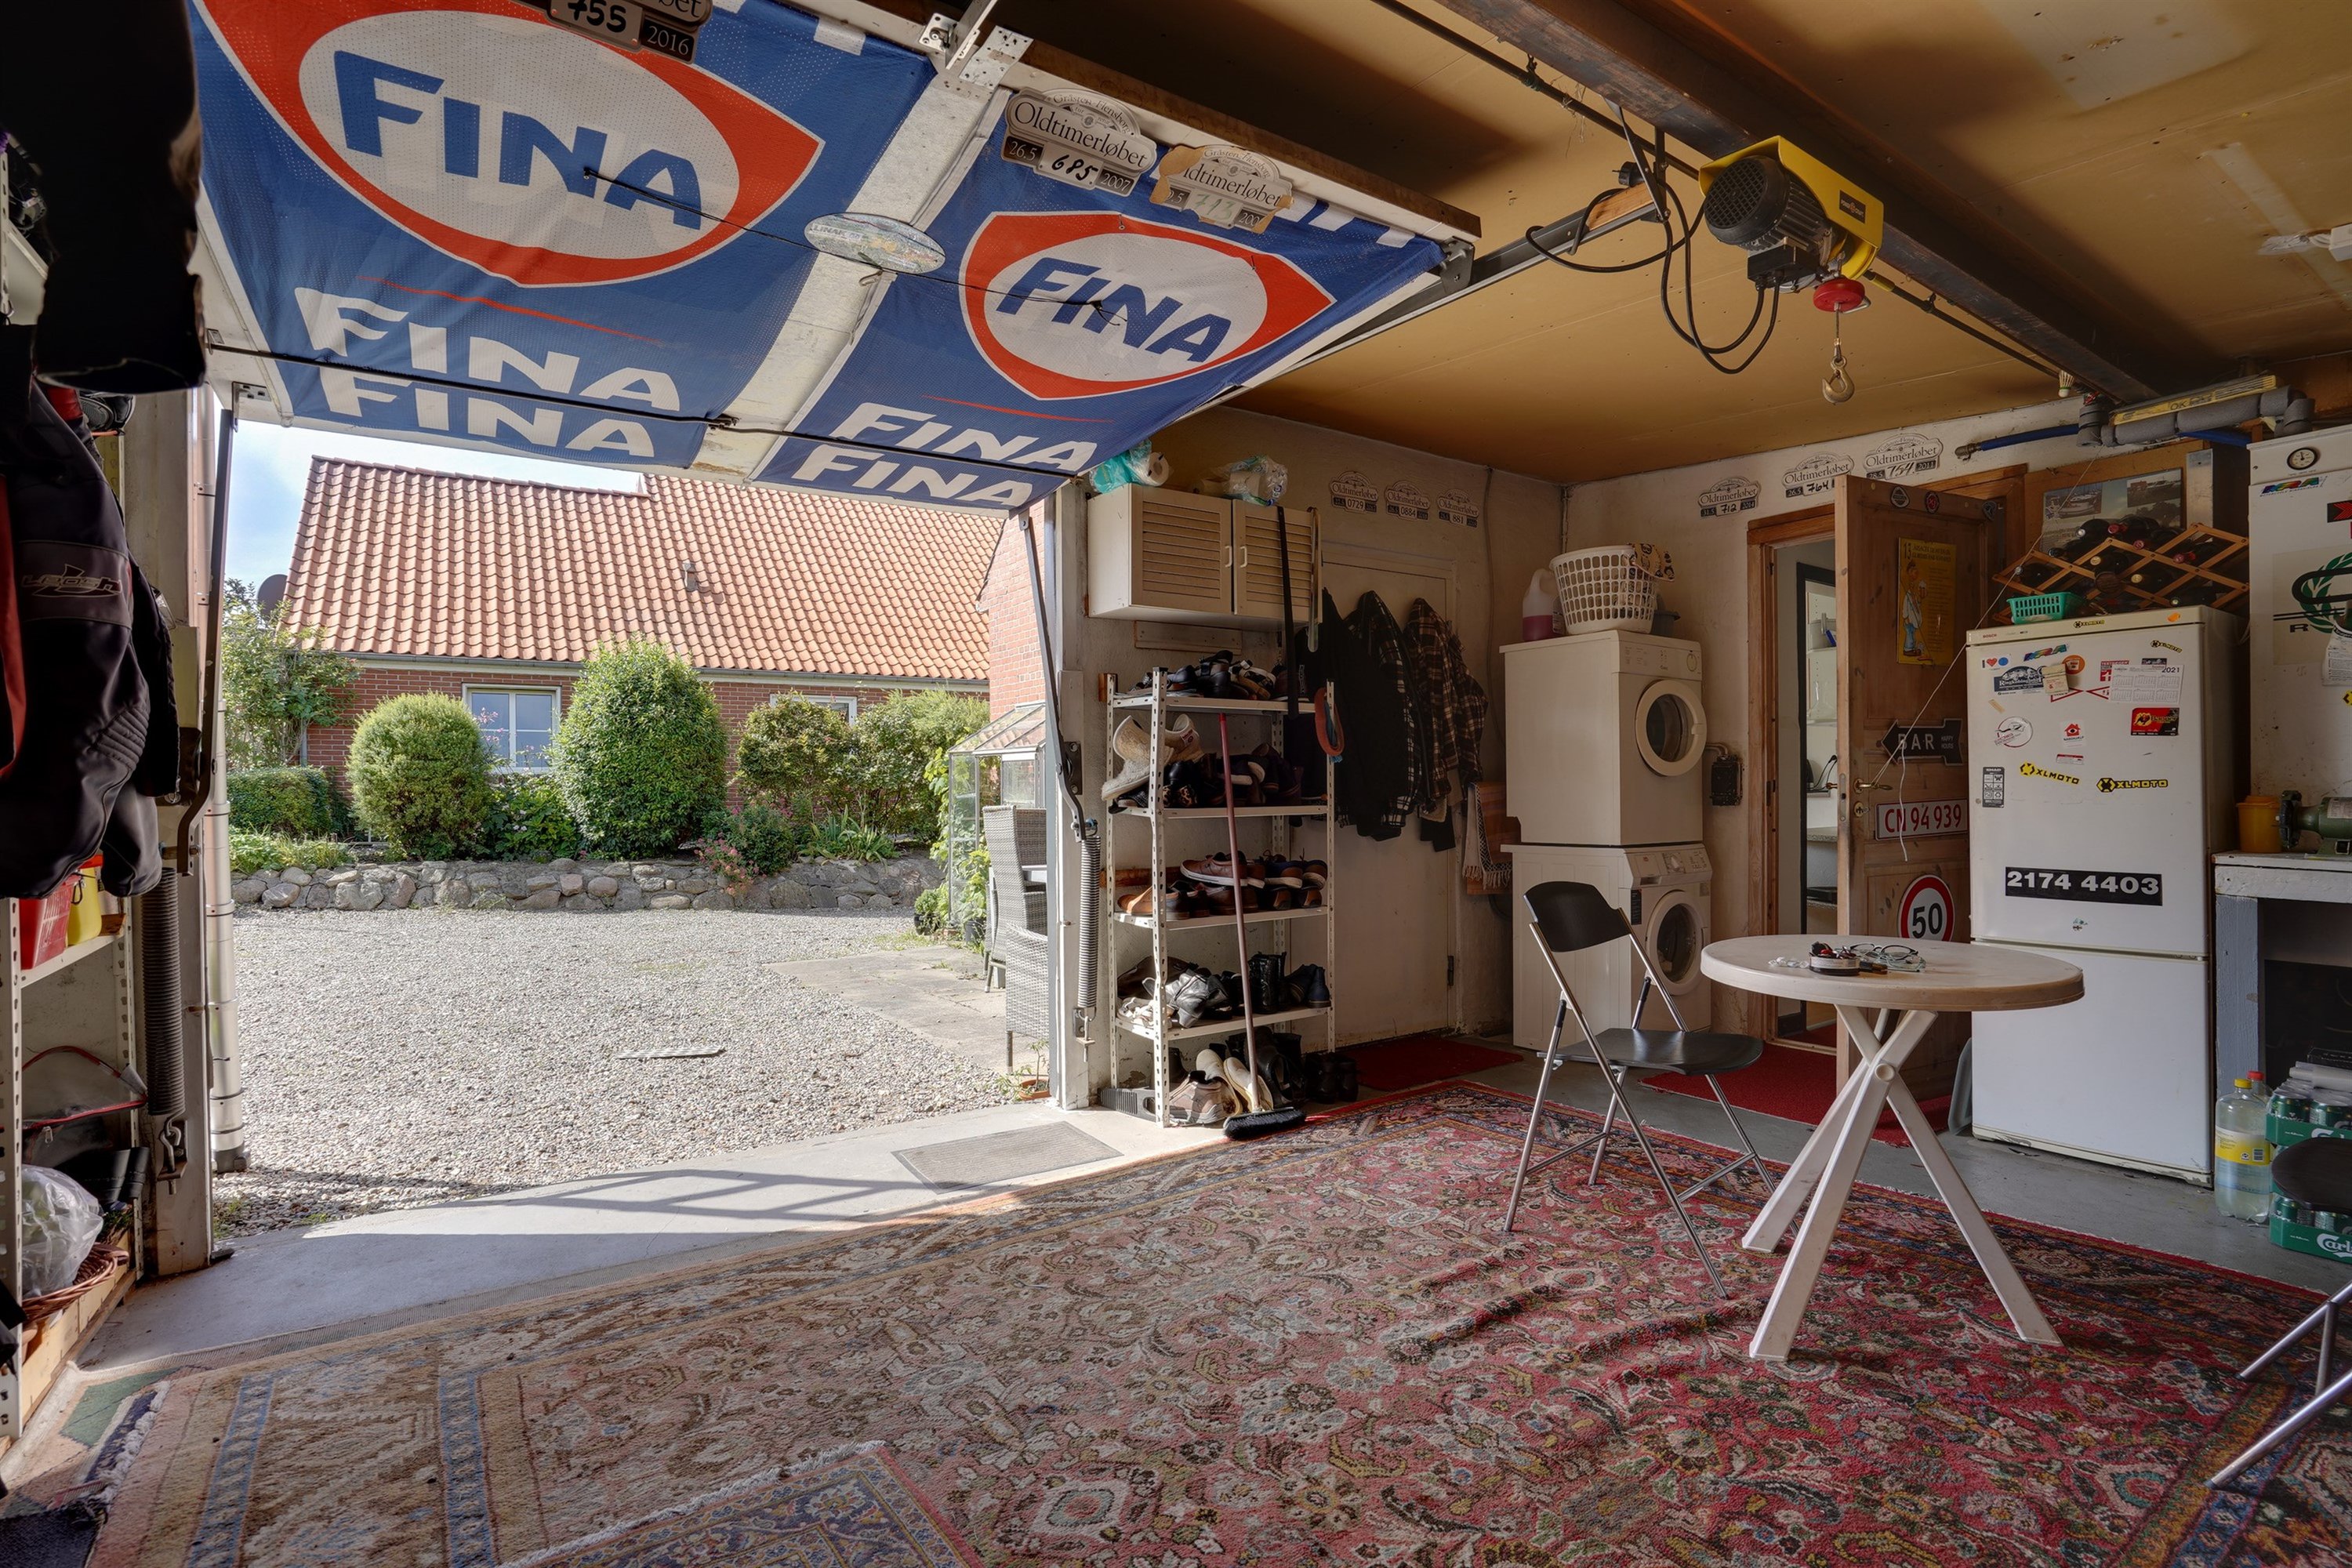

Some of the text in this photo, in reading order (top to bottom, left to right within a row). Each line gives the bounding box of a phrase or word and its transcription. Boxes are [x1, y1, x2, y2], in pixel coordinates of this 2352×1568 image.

[647, 25, 689, 56] 2016
[333, 49, 702, 230] FINA
[1015, 102, 1147, 168] Oldtimerløbet
[1009, 141, 1037, 162] 26.5
[1100, 172, 1131, 192] 2007
[1238, 212, 1261, 227] 200
[996, 256, 1232, 363] FINA
[294, 286, 681, 412] FINA
[320, 367, 655, 458] FINA
[829, 402, 1098, 471] FINA
[1866, 446, 1937, 467] Oldtimerløbet
[1918, 461, 1934, 470] 2011
[791, 444, 1033, 506] FINA
[1784, 463, 1849, 485] Oldtimerløbet
[1332, 483, 1377, 500] Oldtimerløbet
[1387, 491, 1428, 507] Oldtimerløbet
[1700, 488, 1756, 504] Oldtimerløbet
[1348, 499, 1363, 509] 0729
[1400, 506, 1416, 516] 0884
[1439, 499, 1478, 515] Oldtimerløbet
[1453, 514, 1464, 524] 881
[2036, 768, 2080, 785] XLMOTO
[2116, 779, 2169, 789] XLMOTO
[1885, 804, 1962, 833] CN 94 939
[2007, 870, 2159, 895] 2174 4403
[1912, 902, 1943, 939] 50
